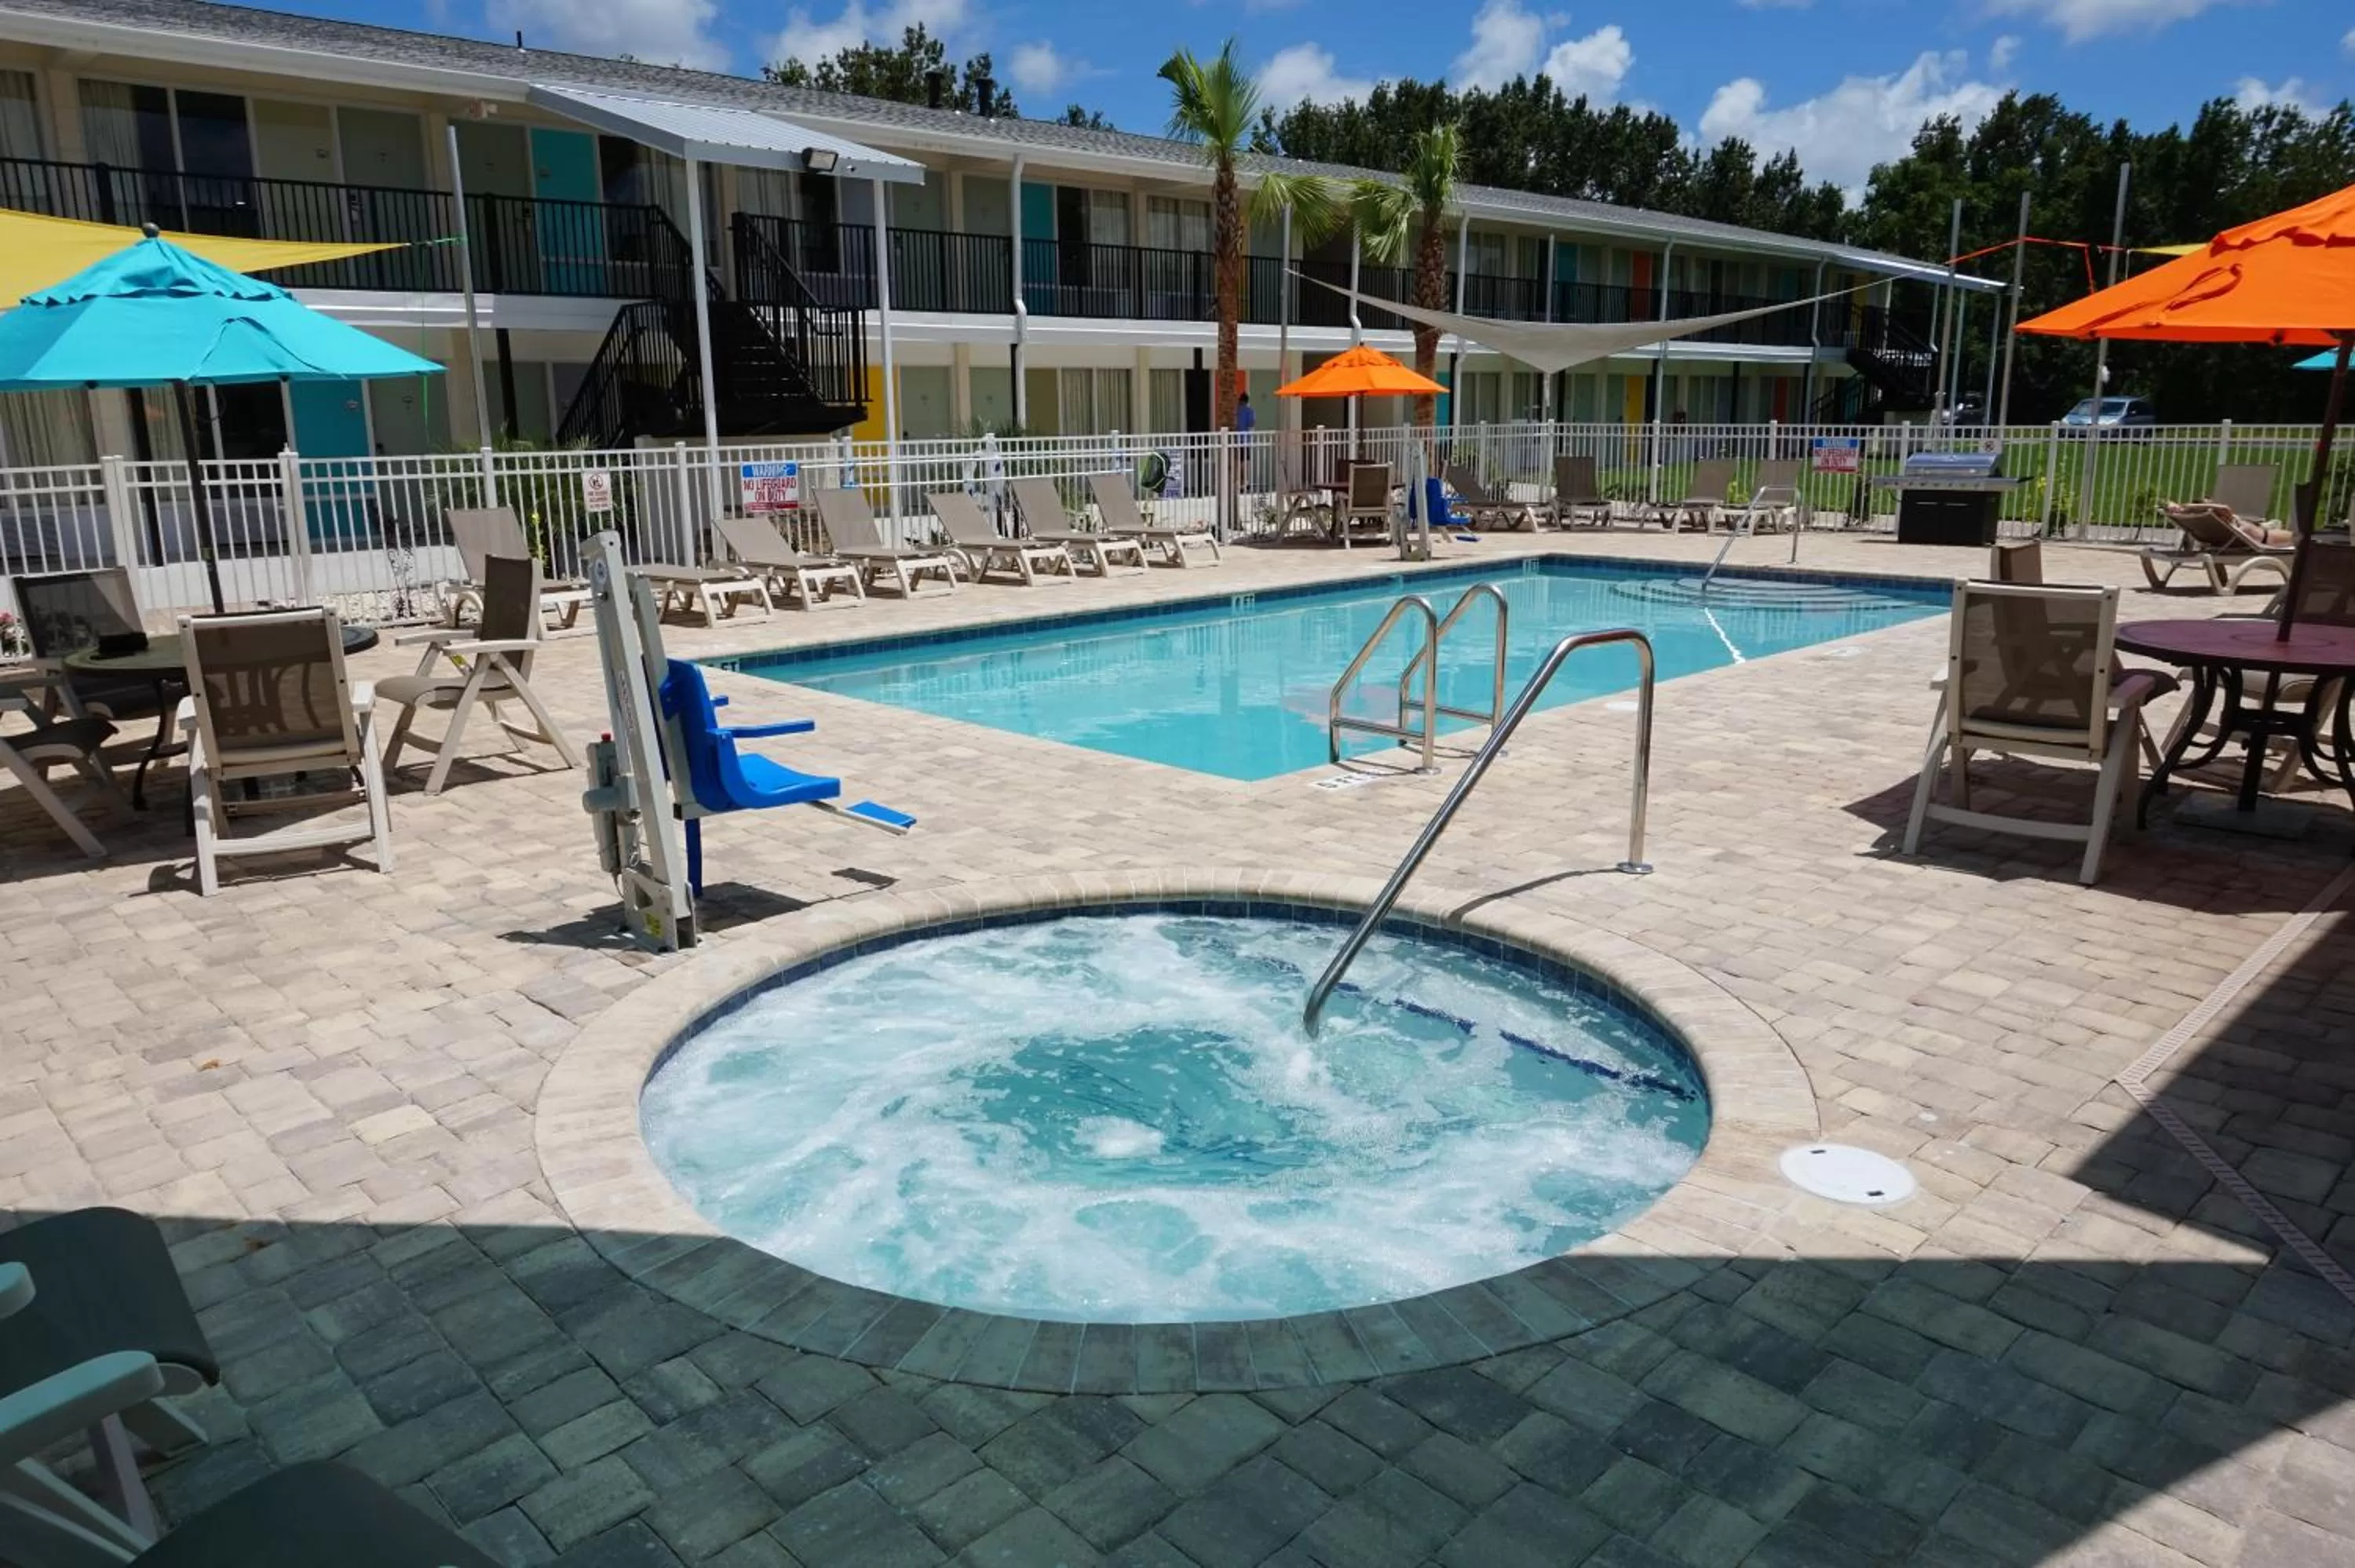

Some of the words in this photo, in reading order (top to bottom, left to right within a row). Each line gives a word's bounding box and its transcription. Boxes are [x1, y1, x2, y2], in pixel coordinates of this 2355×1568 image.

[743, 480, 754, 491] NO
[756, 477, 797, 490] LIFEGUARD
[754, 490, 765, 503] ON
[767, 489, 787, 502] DUTY
